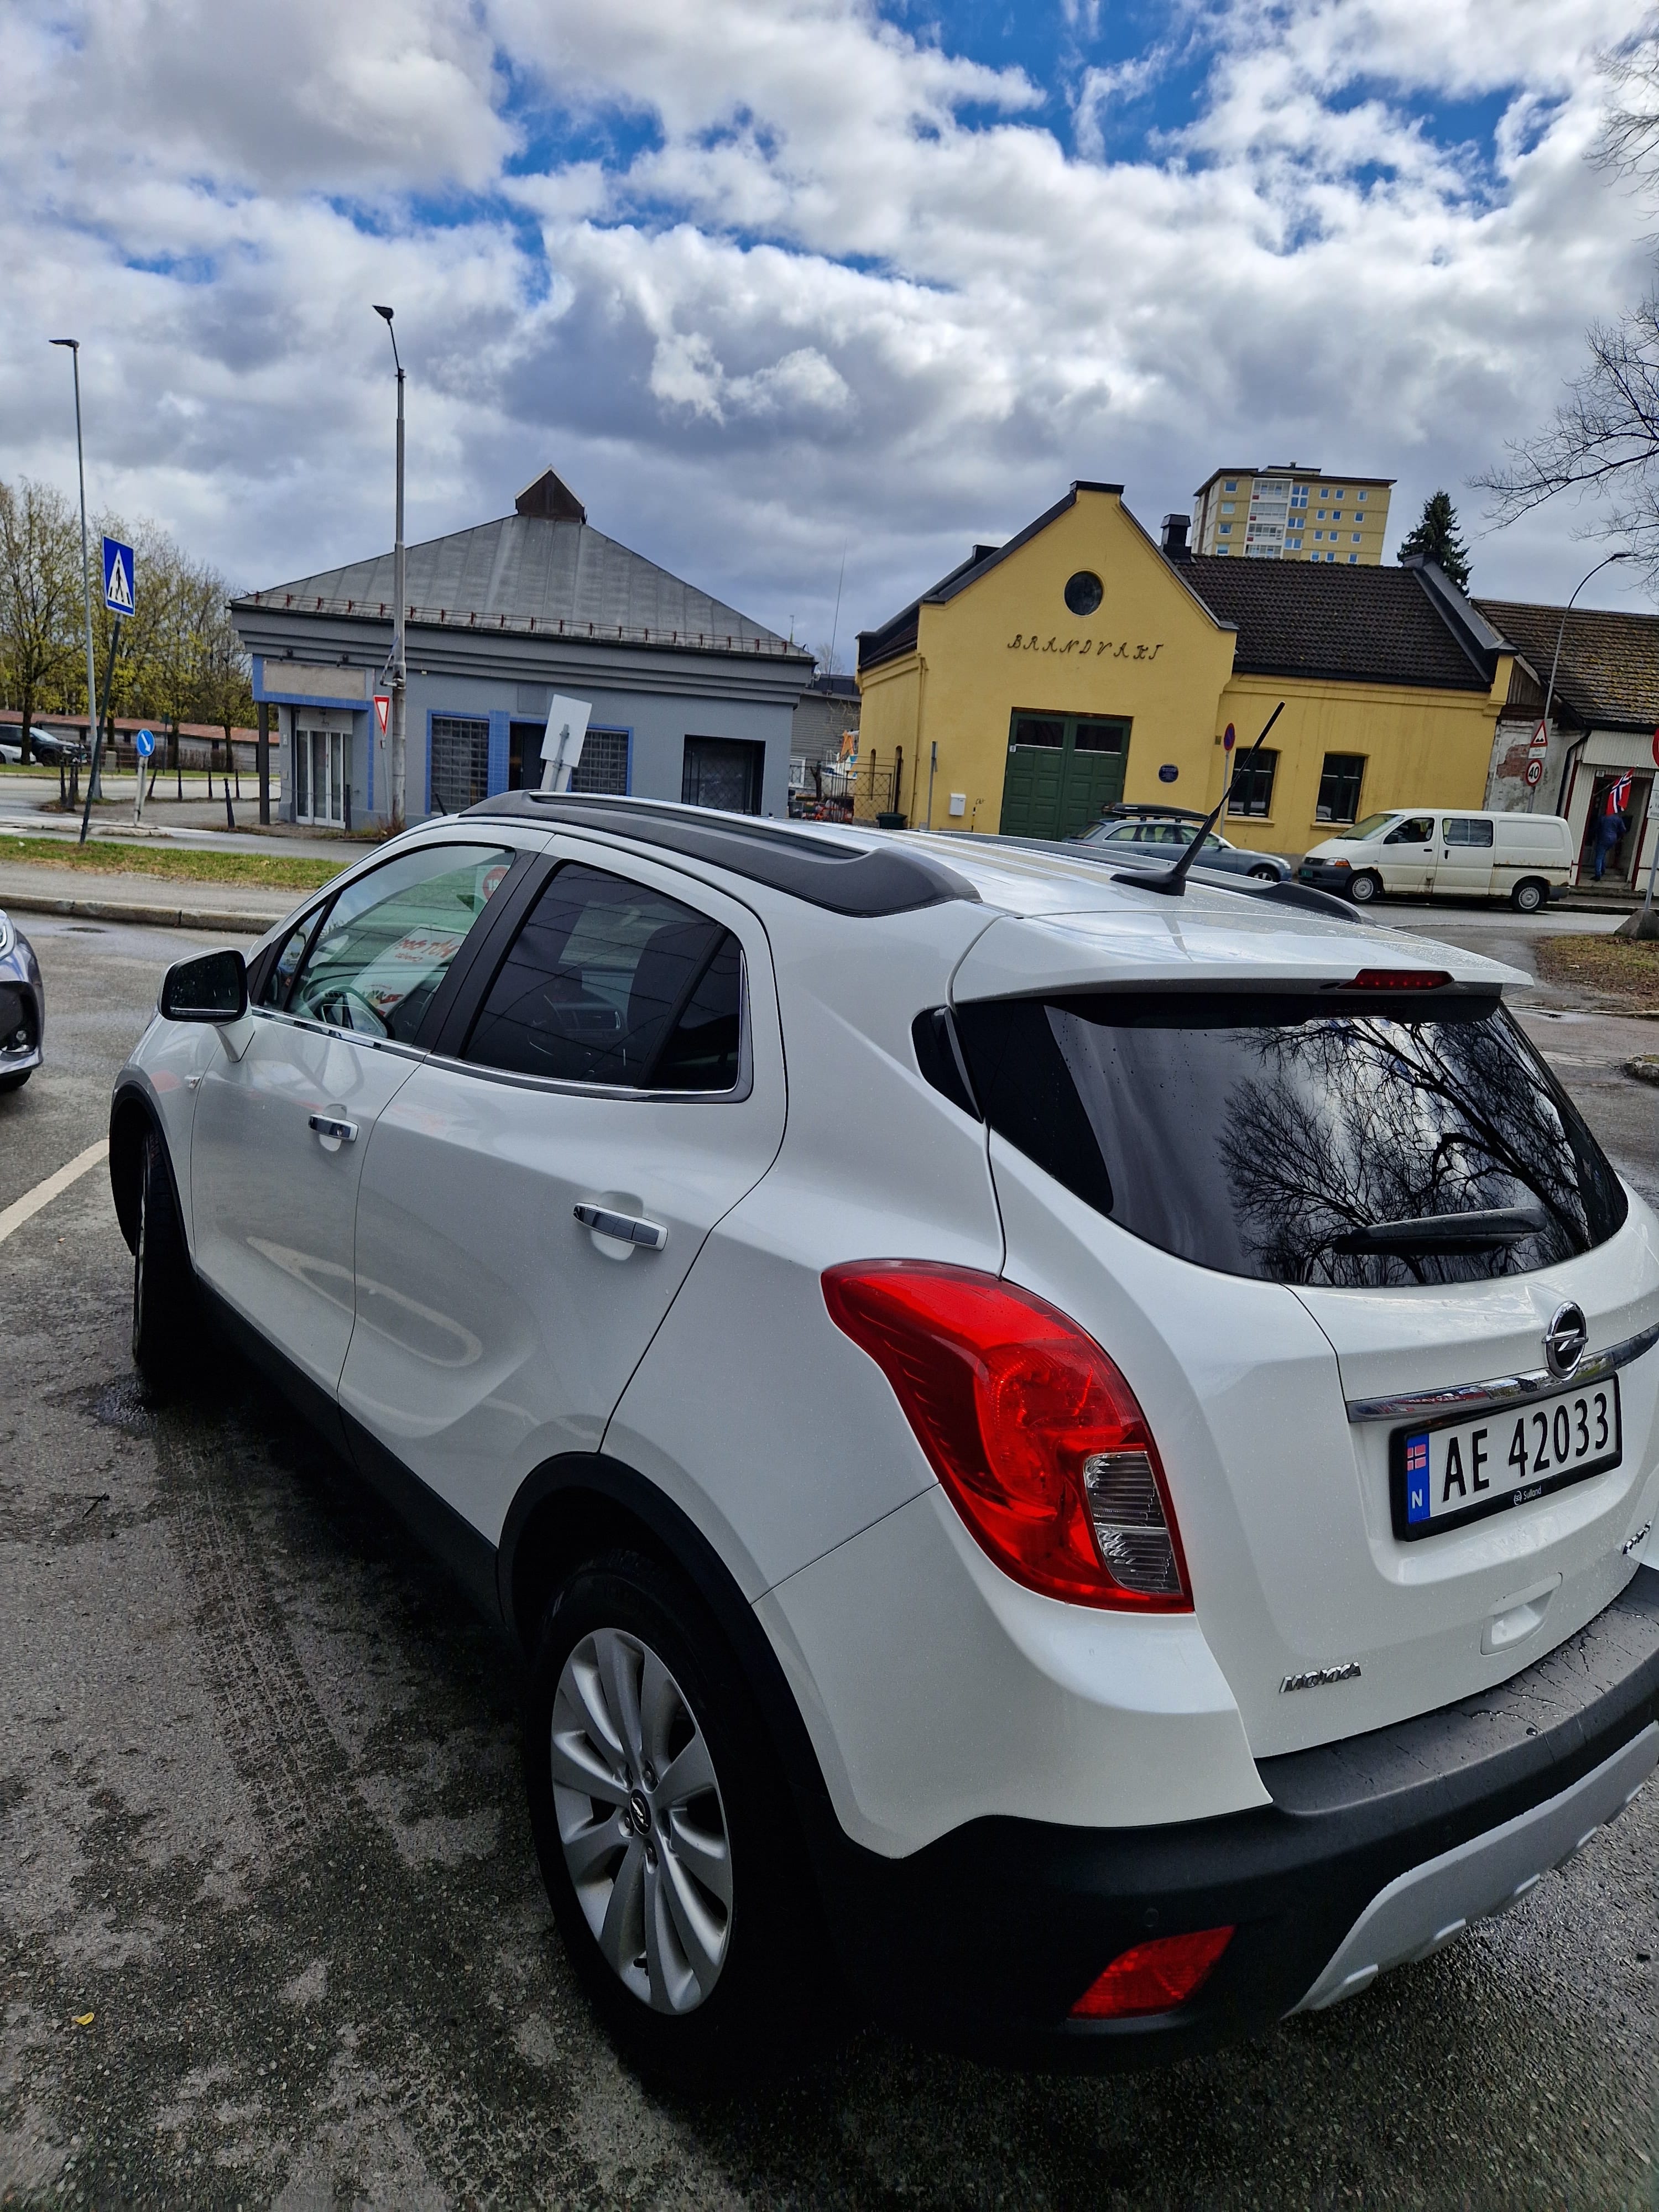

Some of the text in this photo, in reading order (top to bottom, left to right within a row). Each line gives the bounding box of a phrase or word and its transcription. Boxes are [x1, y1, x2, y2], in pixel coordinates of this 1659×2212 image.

[1007, 634, 1164, 660] BRANDVAKT
[1528, 766, 1540, 779] 40
[1442, 1392, 1609, 1503] AE 42033
[1412, 1488, 1422, 1509] N
[1523, 1485, 1541, 1500] Sulland
[1279, 1661, 1361, 1693] MOKKA
